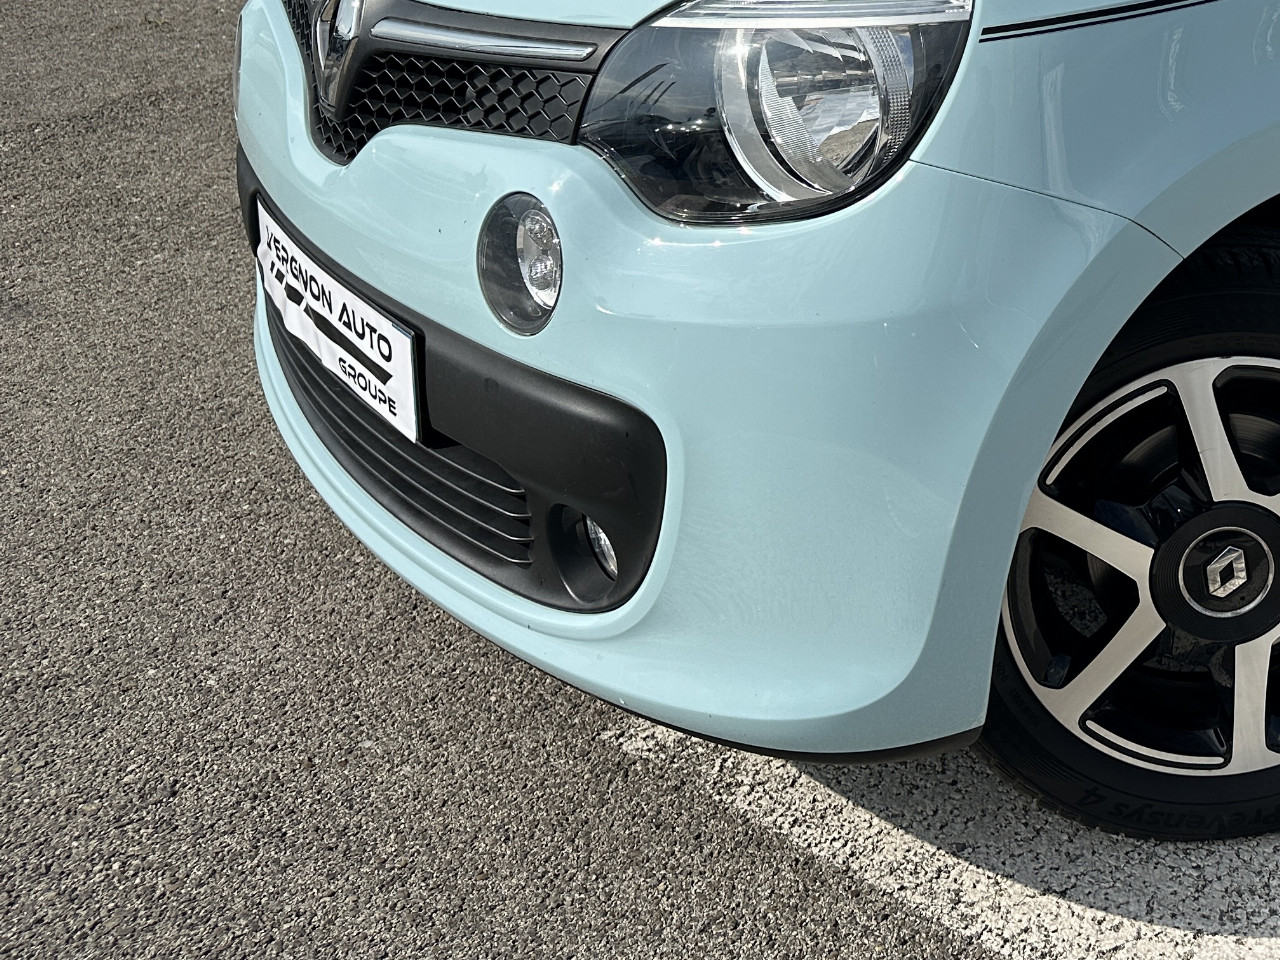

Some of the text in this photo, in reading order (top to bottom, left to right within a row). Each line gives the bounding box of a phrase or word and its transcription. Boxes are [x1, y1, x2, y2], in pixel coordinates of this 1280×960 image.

[265, 225, 393, 363] VERGNON AUTO
[338, 357, 397, 417] GROUPE
[1075, 785, 1108, 808] 4
